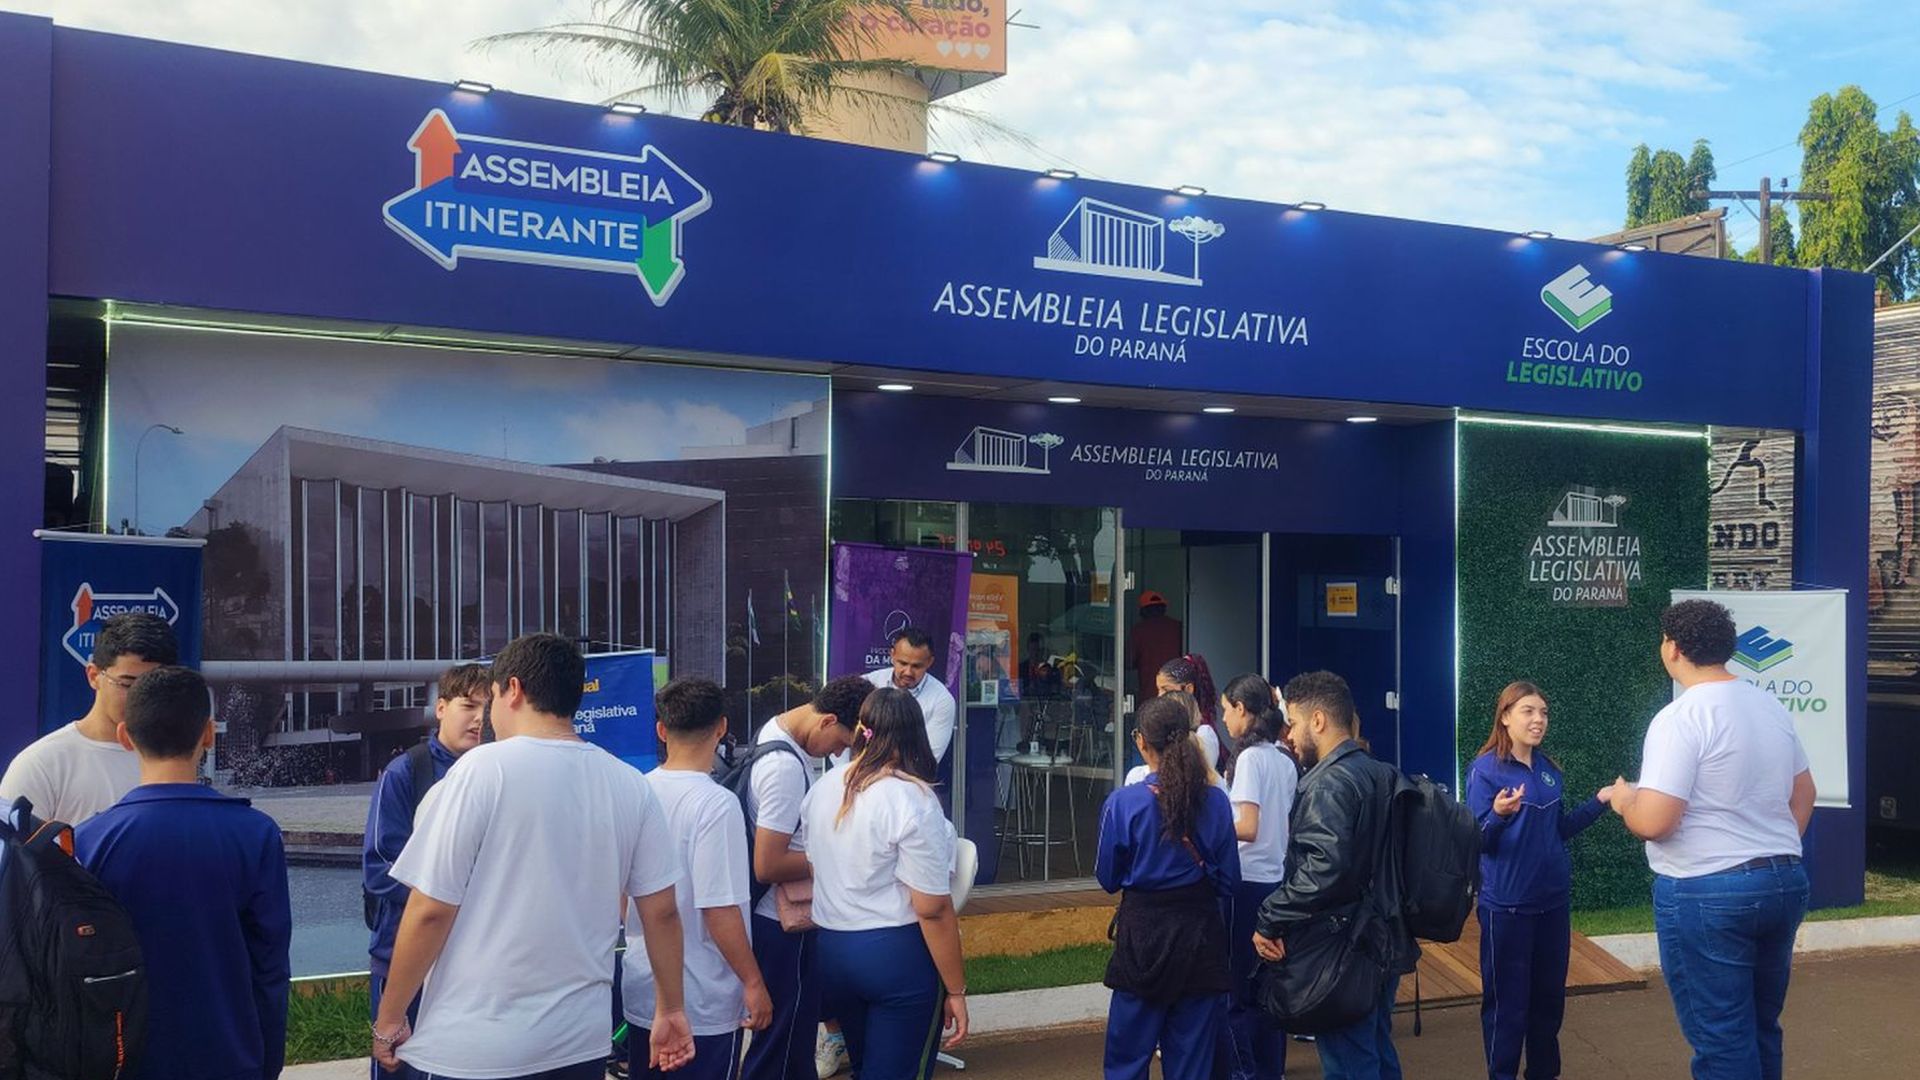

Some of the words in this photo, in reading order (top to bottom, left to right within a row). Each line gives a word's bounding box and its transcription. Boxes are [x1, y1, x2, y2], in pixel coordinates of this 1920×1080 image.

[460, 153, 674, 204] ASSEMBLEIA
[425, 201, 638, 250] ITINERANTE
[933, 282, 1124, 330] ASSEMBLEIA
[1140, 302, 1309, 346] LEGISLATIVA
[1074, 334, 1105, 356] DO
[1110, 338, 1187, 363] PARANÁ
[1522, 337, 1595, 363] ESCOLA
[1599, 344, 1630, 366] DO
[1506, 361, 1643, 392] LEGISLATIVO
[1070, 444, 1173, 466] ASSEMBLEIA
[1181, 449, 1279, 470] LEGISLATIVA
[1145, 469, 1162, 481] DO
[1164, 468, 1209, 482] PARANÁ
[1530, 535, 1641, 557] ASSEMBLEIA
[1713, 522, 1779, 549] NDO
[1529, 560, 1641, 581] LEGISLATIVA
[1553, 587, 1572, 601] DO
[1575, 582, 1623, 601] PARANÁ
[79, 633, 96, 647] ITI
[1782, 680, 1813, 695] DO
[575, 704, 637, 722] egislativa
[1777, 697, 1827, 712] TIVO
